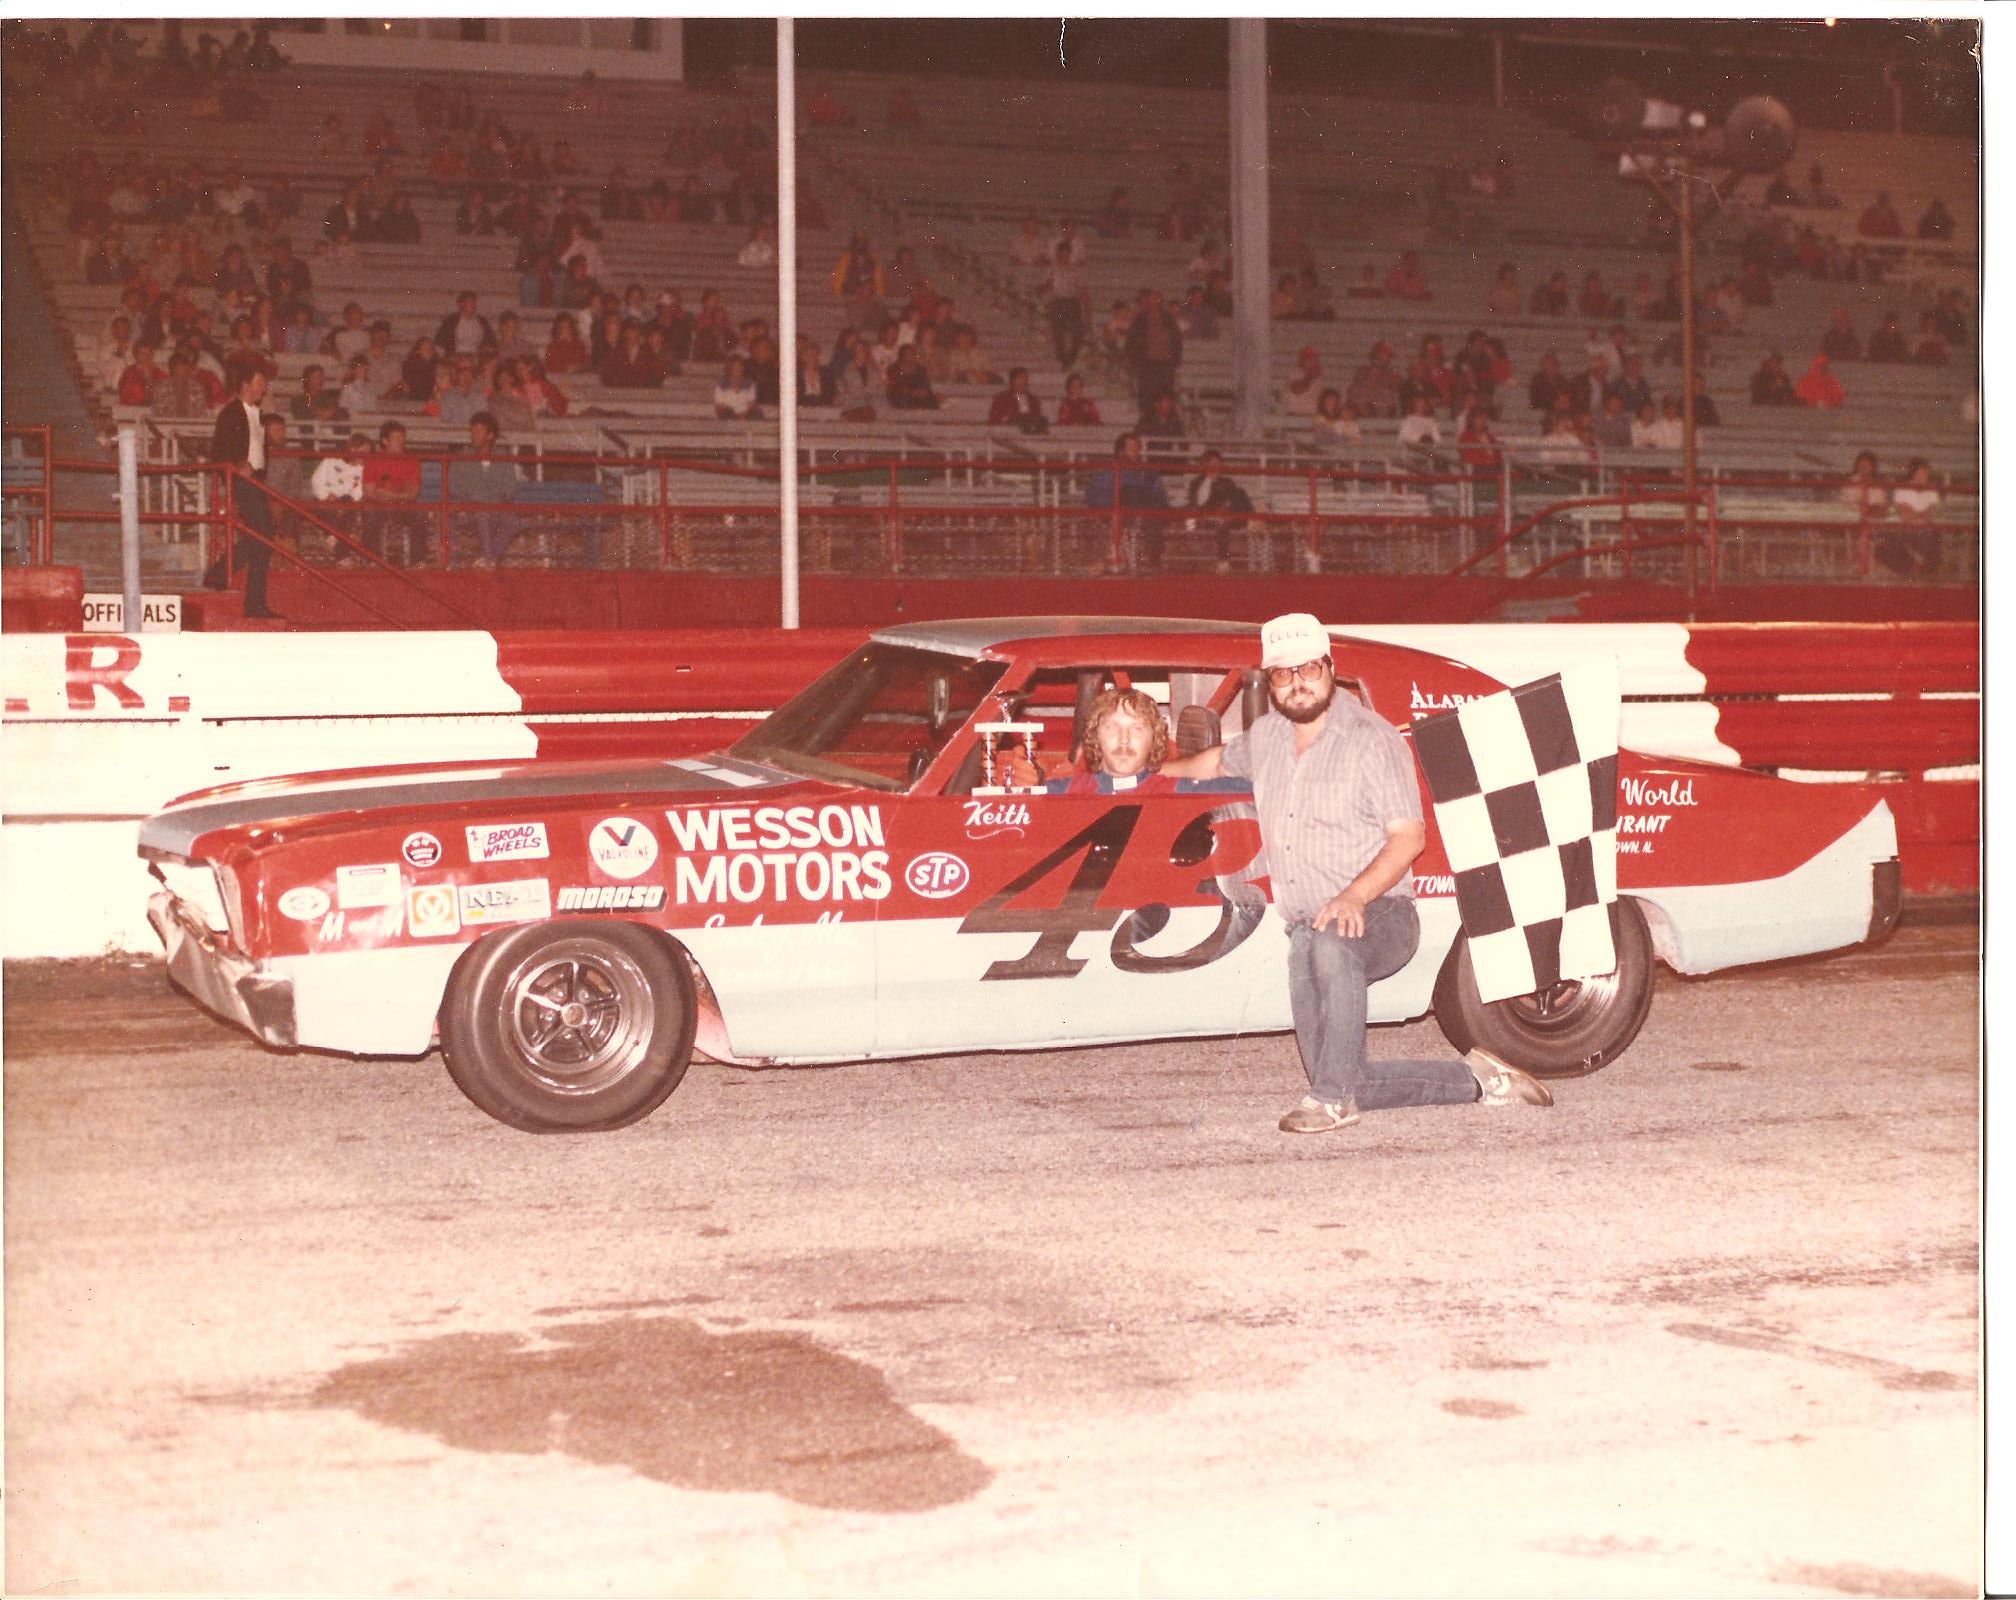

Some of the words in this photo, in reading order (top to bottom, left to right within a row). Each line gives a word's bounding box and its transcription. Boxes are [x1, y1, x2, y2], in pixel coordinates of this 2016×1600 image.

[83, 603, 176, 622] OFFIALS
[1410, 681, 1485, 709] ALABA
[1620, 777, 1698, 806] World
[963, 801, 1031, 826] Keith
[487, 825, 535, 845] BROAD
[665, 805, 886, 851] WESSON
[483, 837, 541, 859] WHEELS
[597, 846, 650, 862] VALVOLINE
[675, 851, 892, 905] MOTORS
[914, 857, 961, 888] STP
[1413, 875, 1456, 895] TOWN
[466, 886, 545, 908] NEAL
[557, 885, 667, 912] MOROSO
[957, 803, 1270, 982] 43
[320, 911, 345, 941] M
